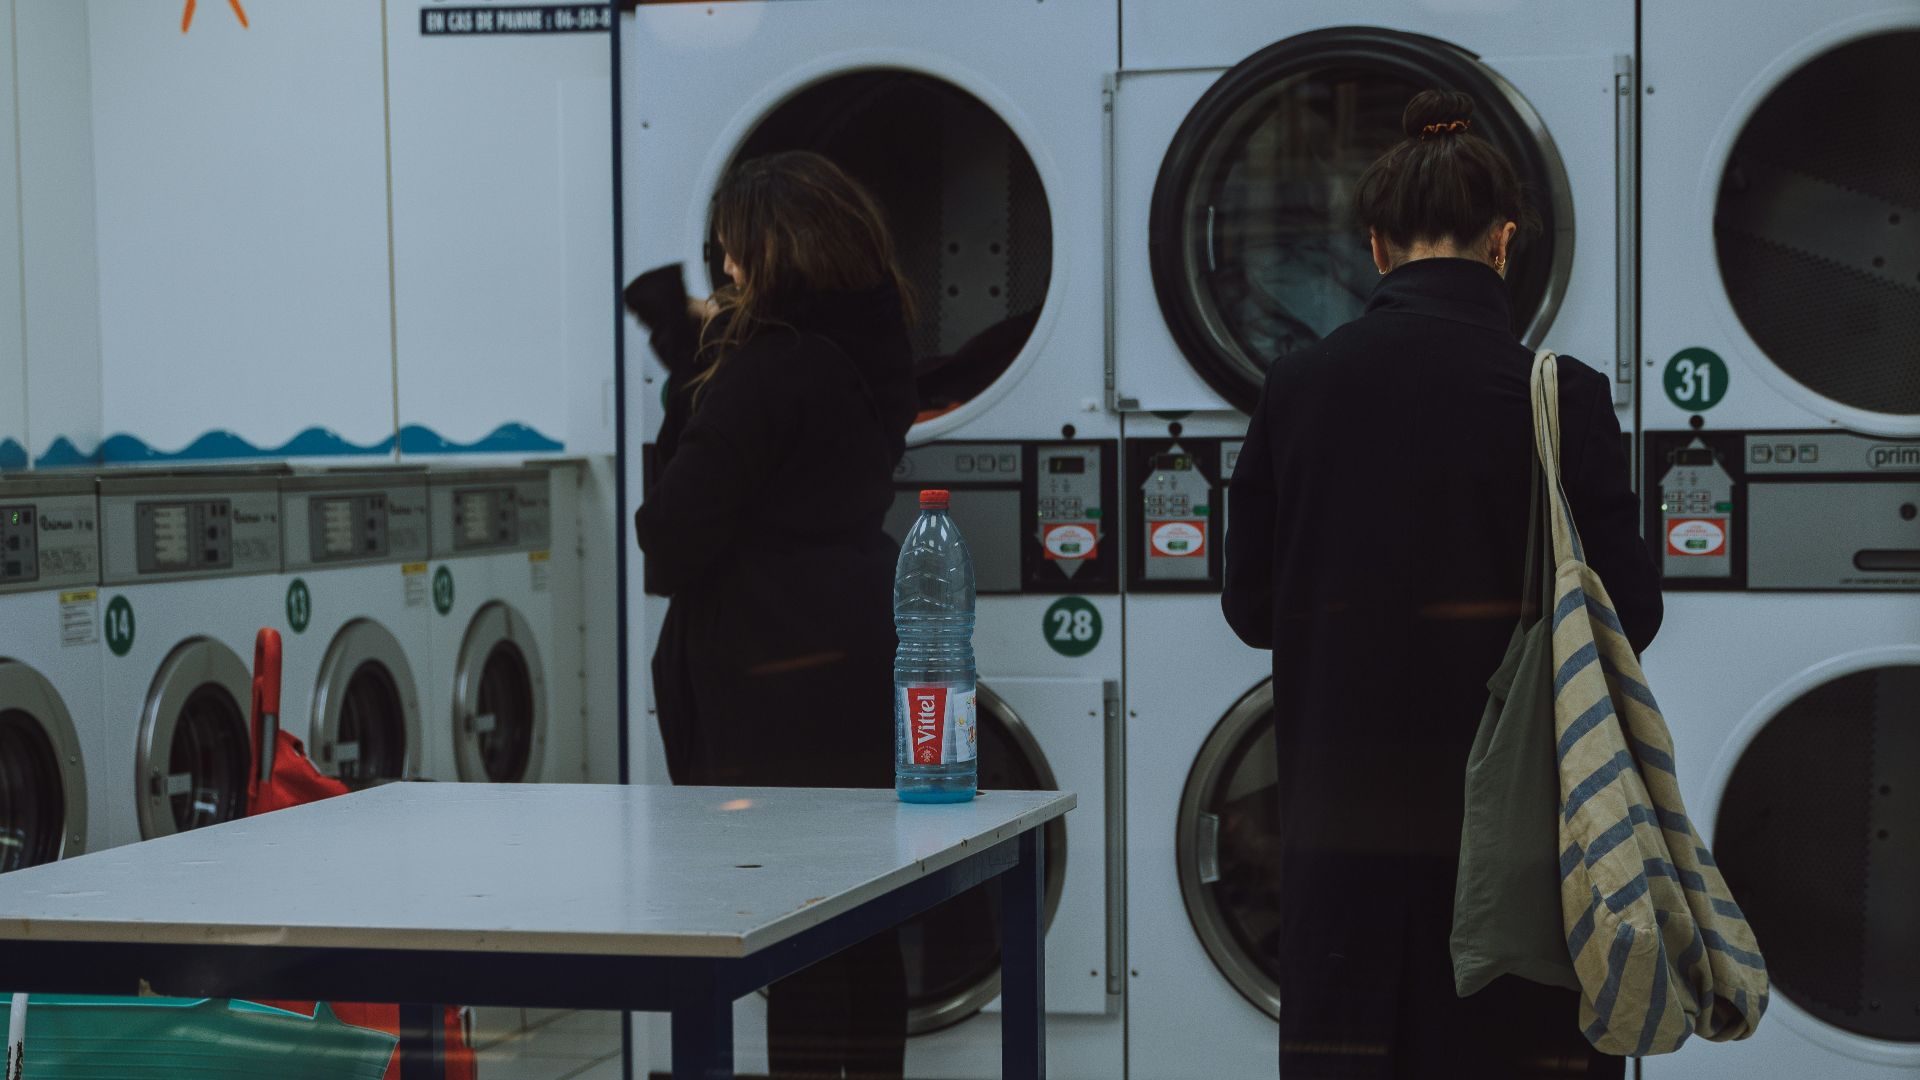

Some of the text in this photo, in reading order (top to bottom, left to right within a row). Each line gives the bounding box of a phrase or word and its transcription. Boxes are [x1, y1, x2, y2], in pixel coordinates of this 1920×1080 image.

[426, 11, 445, 32] EN
[447, 11, 472, 31] CAS
[475, 11, 493, 31] DE
[496, 9, 544, 31] PANNE
[1675, 358, 1711, 402] 31
[109, 608, 129, 641] 14
[1053, 609, 1094, 641] 28
[917, 694, 937, 746] Vittel
